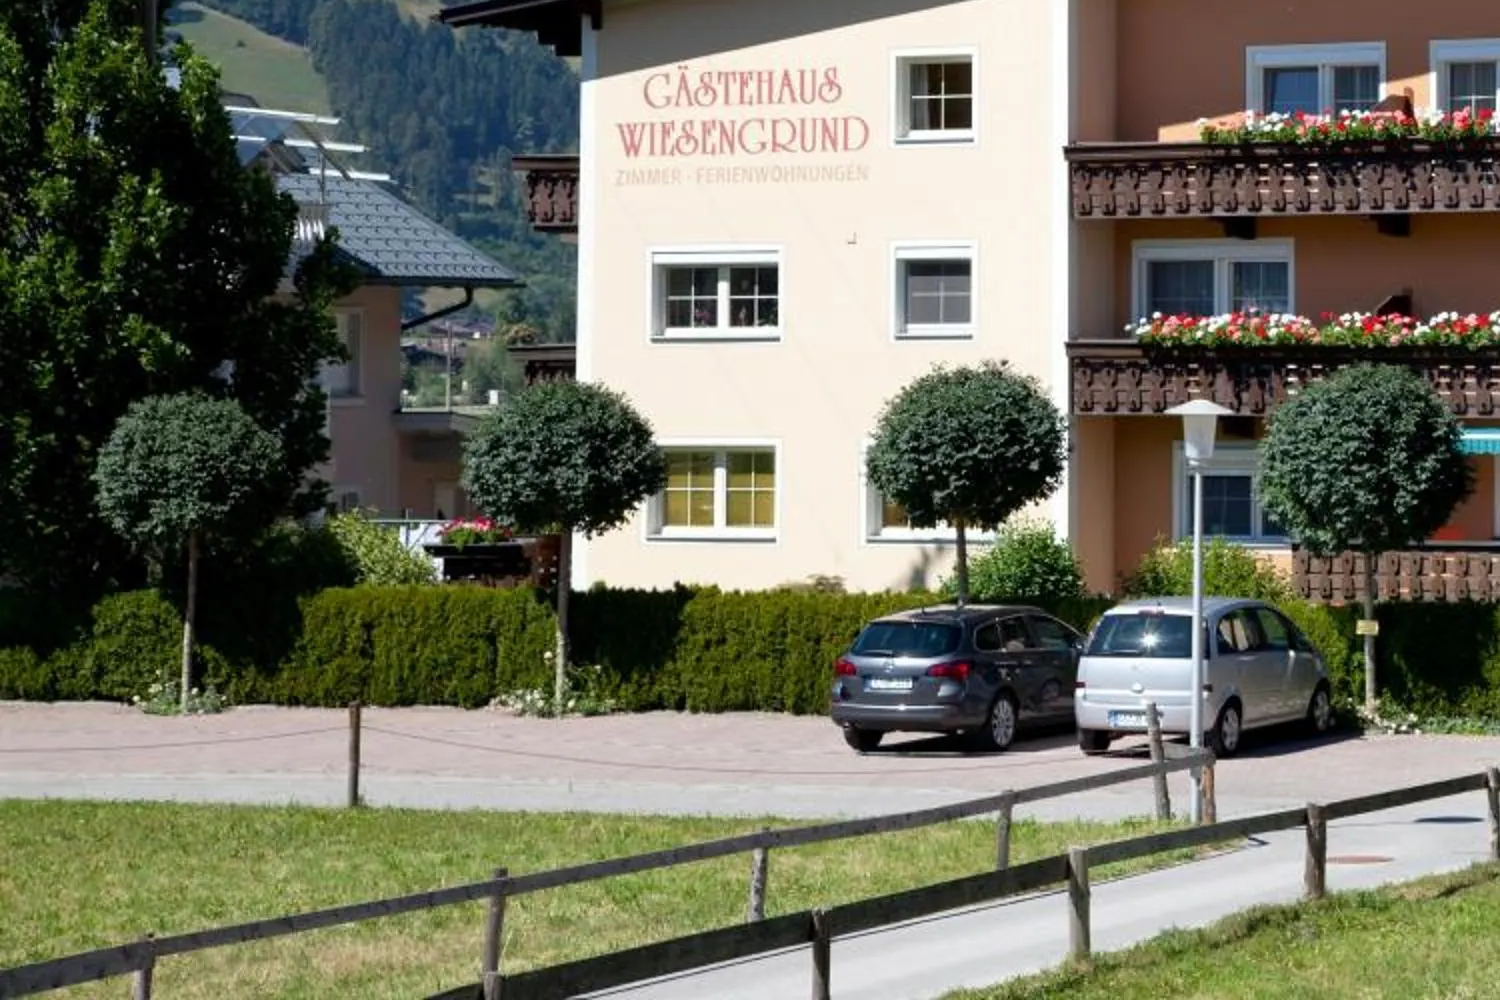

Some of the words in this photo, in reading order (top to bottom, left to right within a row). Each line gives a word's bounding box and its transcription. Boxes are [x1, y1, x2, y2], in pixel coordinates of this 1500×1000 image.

[643, 65, 843, 109] GÄSTEHAUS
[616, 116, 869, 158] WIESENGRUND
[615, 167, 682, 187] ZIMMER
[696, 163, 869, 185] FERIENWOHNUNGEN
